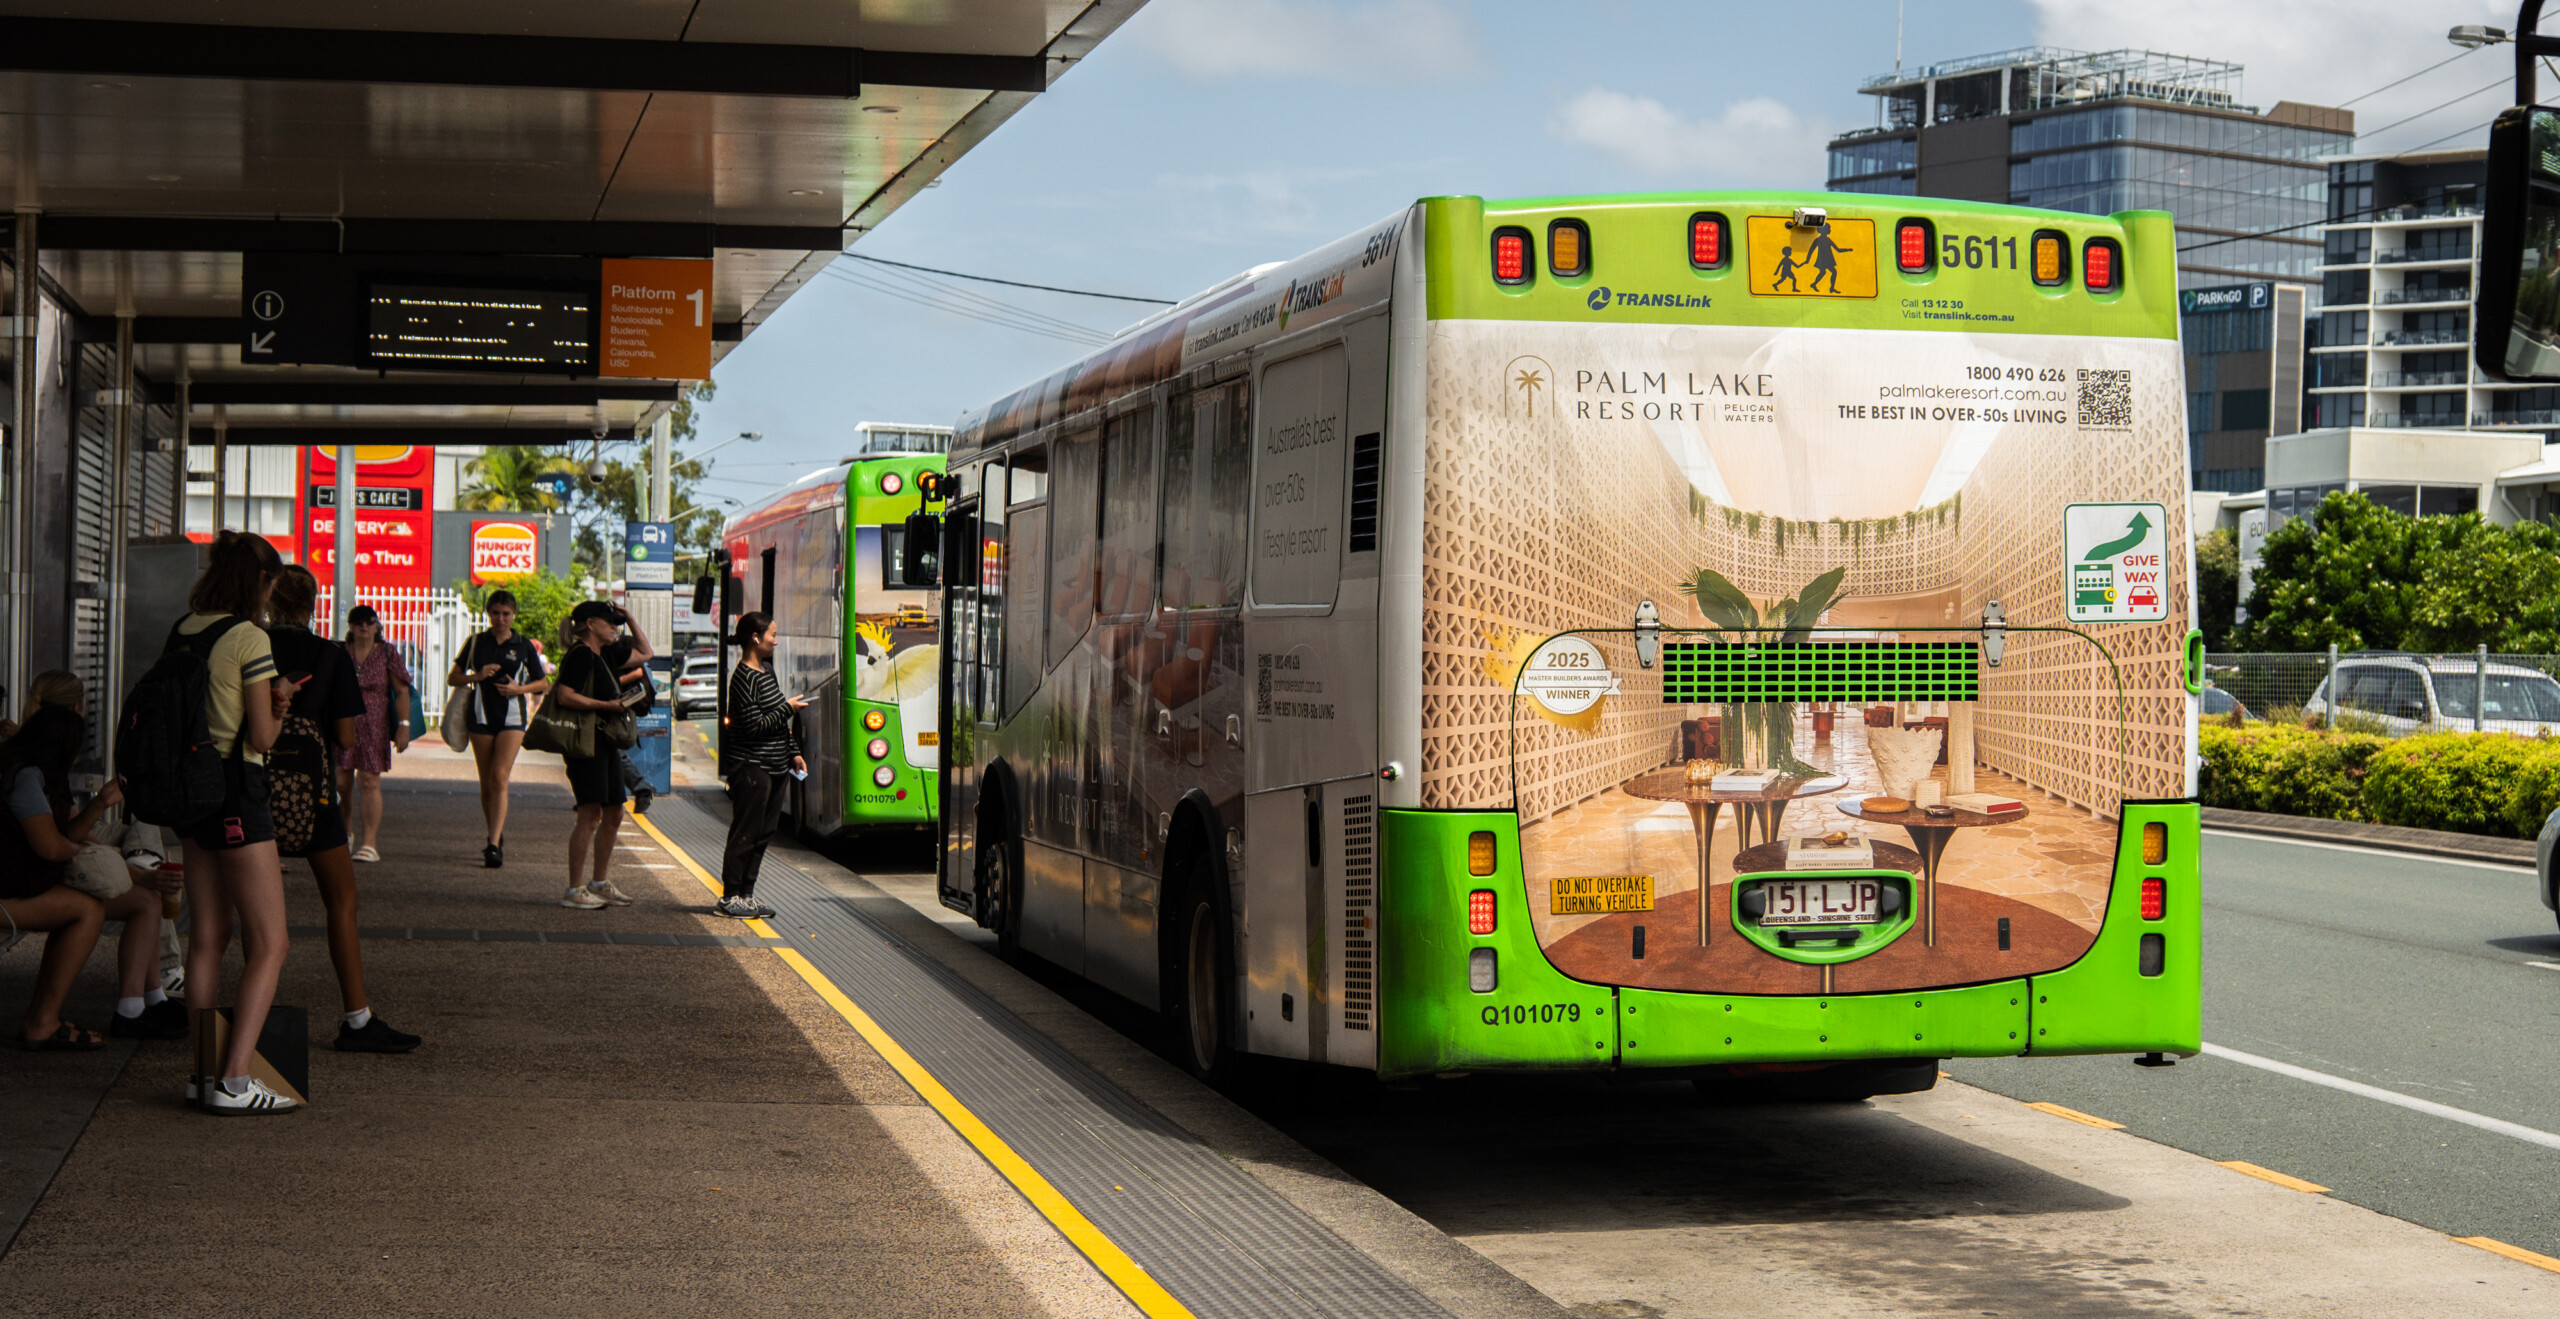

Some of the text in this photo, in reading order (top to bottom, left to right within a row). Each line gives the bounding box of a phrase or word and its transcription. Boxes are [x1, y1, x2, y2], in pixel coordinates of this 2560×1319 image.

[1362, 223, 1397, 268] 5611
[1942, 234, 2017, 270] 5611
[1292, 269, 1346, 314] TRANSLink
[2197, 286, 2264, 305] PARKnGO P
[611, 284, 704, 327] Platform 1
[1616, 293, 1712, 308] TRANSLink
[1901, 299, 1963, 309] Call 13 12 30
[611, 304, 674, 315] Southbound to
[1902, 310, 2015, 322] Visit translink.com.au
[610, 326, 649, 337] Buderim,
[1194, 322, 1241, 353] translink.com.au
[610, 337, 647, 347] Kawana,
[609, 348, 656, 359] Caloundra,
[609, 359, 630, 368] USC
[1966, 366, 2066, 382] 1800 490 626
[1576, 370, 1774, 397] PALM LAKE
[1880, 384, 2067, 401] palmlakeresort.com.au
[1577, 401, 1704, 421] RESORT
[1724, 404, 1774, 412] PELICAN
[1838, 405, 2067, 424] THE BEST IN OVER-50s LIVING
[1724, 414, 1774, 423] WATERS
[1267, 412, 1337, 456] Australia's best
[329, 490, 366, 505] J'S
[1264, 472, 1305, 508] over-50s
[313, 519, 388, 535] DEERY
[476, 541, 532, 552] HUNGRY
[1262, 523, 1328, 565] lifestyle resort
[373, 549, 414, 566] Thru
[476, 554, 531, 568] JACK'S
[2123, 555, 2159, 567] GIVE
[2124, 572, 2158, 583] WAY
[1547, 652, 1590, 668] 2025
[1546, 689, 1590, 700] WINNER
[854, 794, 896, 804] Q101079
[1557, 876, 1647, 895] DO NOT OVERTAKE
[1559, 893, 1647, 912] TURNING VEHICLE
[1765, 915, 1811, 924] QUEENSLAND
[1817, 914, 1852, 922] SUNSHINE
[1481, 1003, 1581, 1026] Q101079
